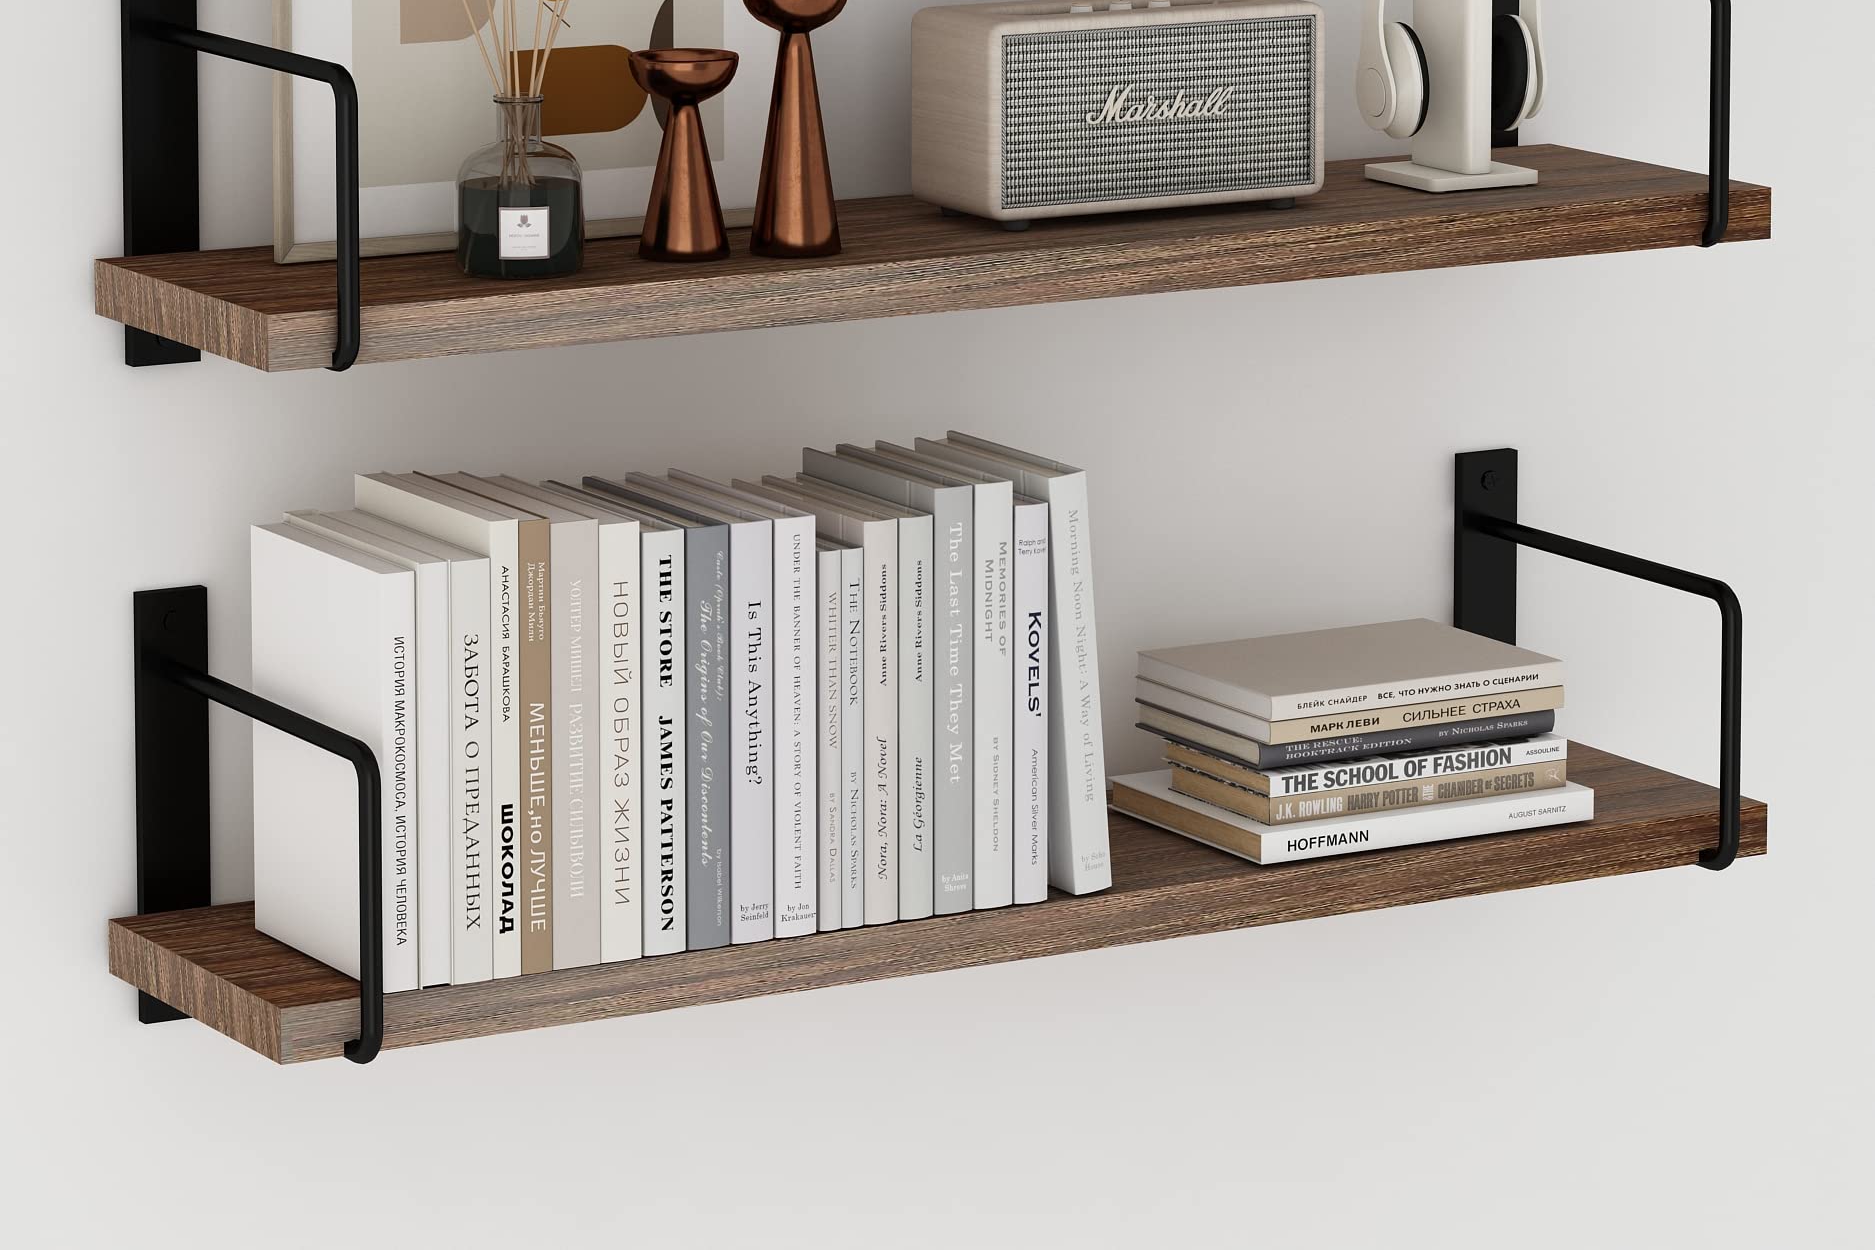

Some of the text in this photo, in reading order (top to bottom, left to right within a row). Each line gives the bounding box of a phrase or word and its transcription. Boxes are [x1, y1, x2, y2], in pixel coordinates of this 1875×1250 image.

[1086, 83, 1235, 125] Marshall
[793, 534, 801, 573] UNDER
[537, 562, 545, 603] Мартин
[793, 577, 801, 601] THE
[985, 559, 994, 642] MIDNIGHT
[999, 541, 1007, 657] MEMORIES OF
[501, 565, 511, 723] АНАСТАСИЯ БАРАШКОВА
[659, 555, 673, 688] THE STORE
[793, 606, 801, 651] BANNER
[849, 578, 861, 706] THE NOTEBOOK
[915, 560, 923, 683] Anne Rivers Siddons
[793, 656, 801, 671] OF
[828, 592, 837, 749] WHITER THAN SNOW
[947, 522, 963, 783] The Last Time They Met
[1028, 611, 1042, 717] KOVELS'
[1068, 510, 1094, 802] Morning Noon Night: A Way of Living
[745, 600, 763, 785] Is This Anything?
[793, 676, 801, 725] HEAVEN:
[1297, 695, 1368, 709] БЛЕЙК СНАЙДЕР
[1377, 673, 1539, 700] ВСЕ, ЧТО НУЖНО ЗНАТЬ О СЦЕНАРИИ
[695, 600, 713, 867] The Origins of Our Discontents
[1310, 717, 1380, 733] МАРК ЛЕВИ
[1402, 699, 1521, 723] СИЛЬНЕЕ СТРАХА
[1451, 724, 1495, 736] NICHOLAS
[1497, 720, 1529, 729] SPARKS
[613, 581, 632, 905] НОВЫЙ ОБРАЗ ЖИЗНИ
[1285, 736, 1363, 752] THE RESCUE:
[1285, 738, 1412, 760] BOOKTRACK EDITION
[1526, 746, 1560, 756] ASSOULINE
[394, 636, 407, 946] ИСТОРИЯ МАКРОКОСМОСА, ИСТОРИЯ ЧЕЛОВЕКА
[462, 634, 481, 931] ЗАБОТА О ПРЕДАННЫХ
[794, 782, 801, 796] OF
[1031, 749, 1039, 802] American
[1281, 747, 1512, 794] THE SCHOOL OF FASHION
[1347, 791, 1380, 811] HARRY
[1382, 787, 1419, 806] POTTER
[1437, 778, 1484, 799] CHAMBER
[1494, 772, 1534, 792] SECRETS
[876, 736, 889, 880] Nora, Nora: A Novel
[912, 757, 925, 851] La Géorgienne
[992, 737, 1000, 852] BY SIDNEY SHELDON
[1276, 796, 1343, 820] J.K. ROWLING
[1508, 805, 1567, 820] AUGUST SARNITZ
[658, 716, 674, 931] JAMES PATTERSON
[850, 772, 859, 889] BY NICHOLAS SPARKS
[1031, 805, 1039, 831] Silver
[1287, 829, 1369, 852] HOFFMANN
[499, 804, 514, 934] ШОКОЛАД
[530, 849, 546, 933] ЛУЧШЕ
[794, 855, 802, 889] FAITH
[740, 902, 769, 913] by Jerry
[740, 911, 769, 922] Seinfeld
[781, 911, 817, 922] Krakauer
[787, 903, 810, 913] by Jon
